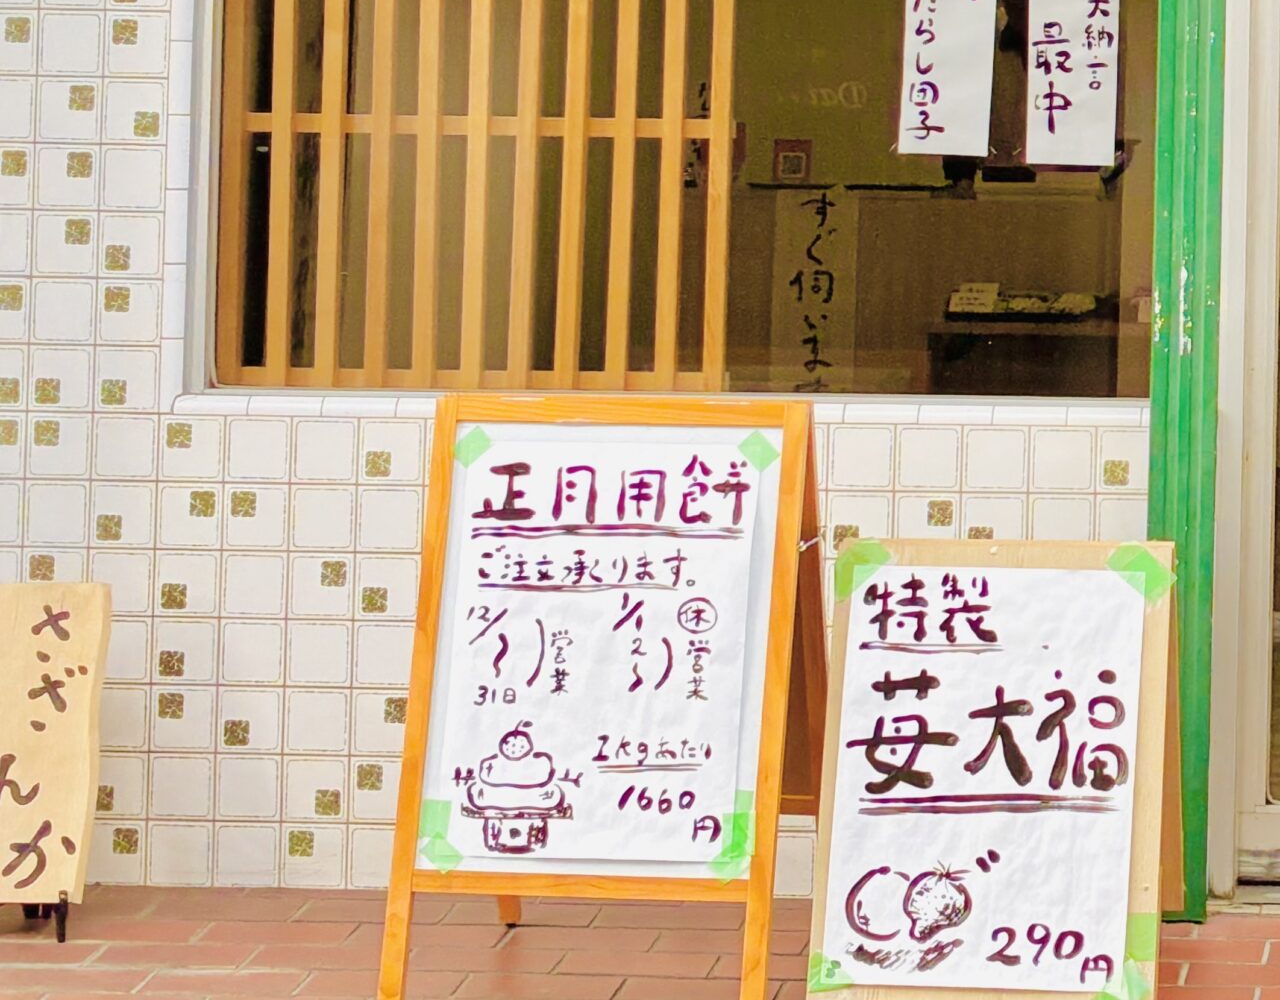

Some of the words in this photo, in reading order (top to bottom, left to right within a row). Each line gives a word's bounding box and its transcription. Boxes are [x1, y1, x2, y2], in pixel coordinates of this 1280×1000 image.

[1031, 21, 1074, 135] 最中
[471, 454, 752, 526] 正月用餅
[477, 545, 696, 588] ご注文承ります。
[862, 572, 998, 643] 特製
[549, 629, 574, 695] 営業
[685, 639, 711, 701] 営業
[846, 668, 1130, 791] 苺大福
